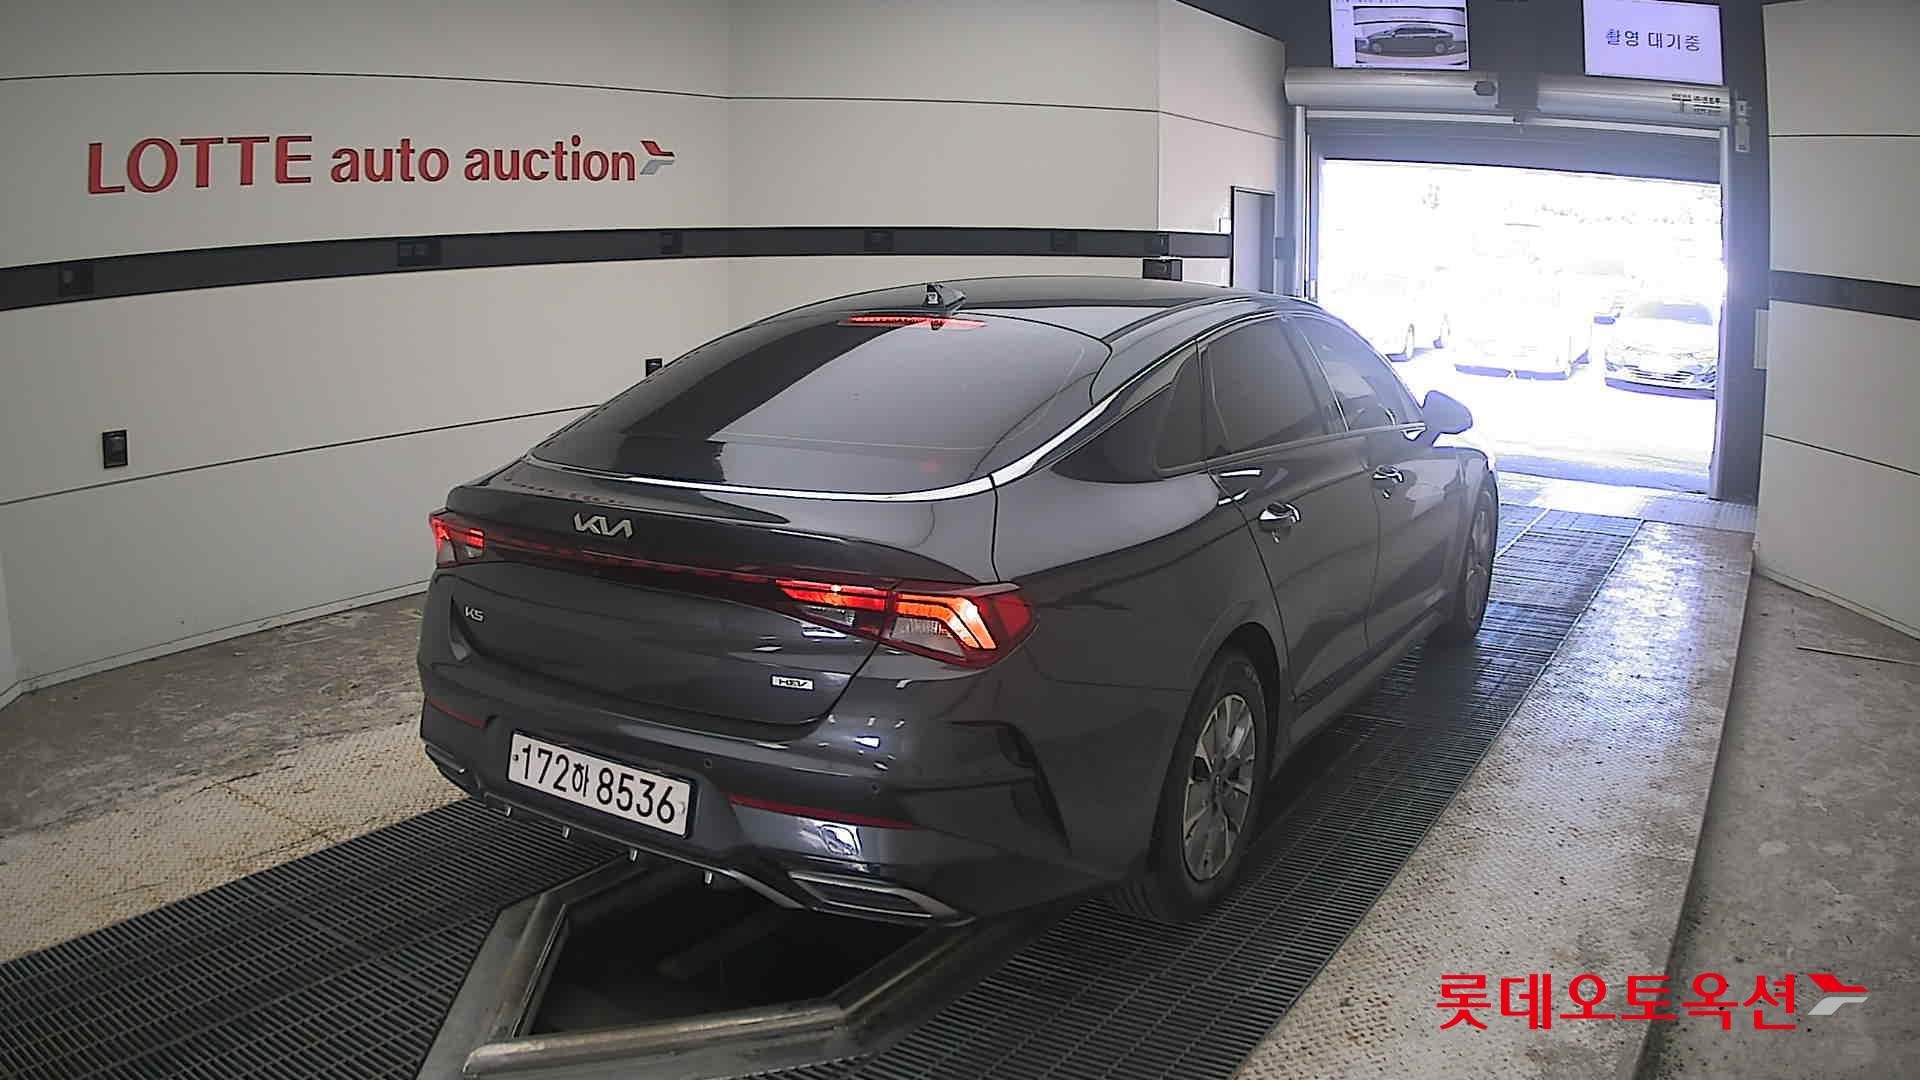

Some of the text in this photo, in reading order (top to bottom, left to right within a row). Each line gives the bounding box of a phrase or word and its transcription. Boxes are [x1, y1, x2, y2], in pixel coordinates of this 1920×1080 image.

[1606, 28, 1700, 51] 촬영 대기중
[87, 134, 637, 194] LOTTE auto auction
[573, 512, 633, 539] KIA
[464, 606, 485, 622] K5
